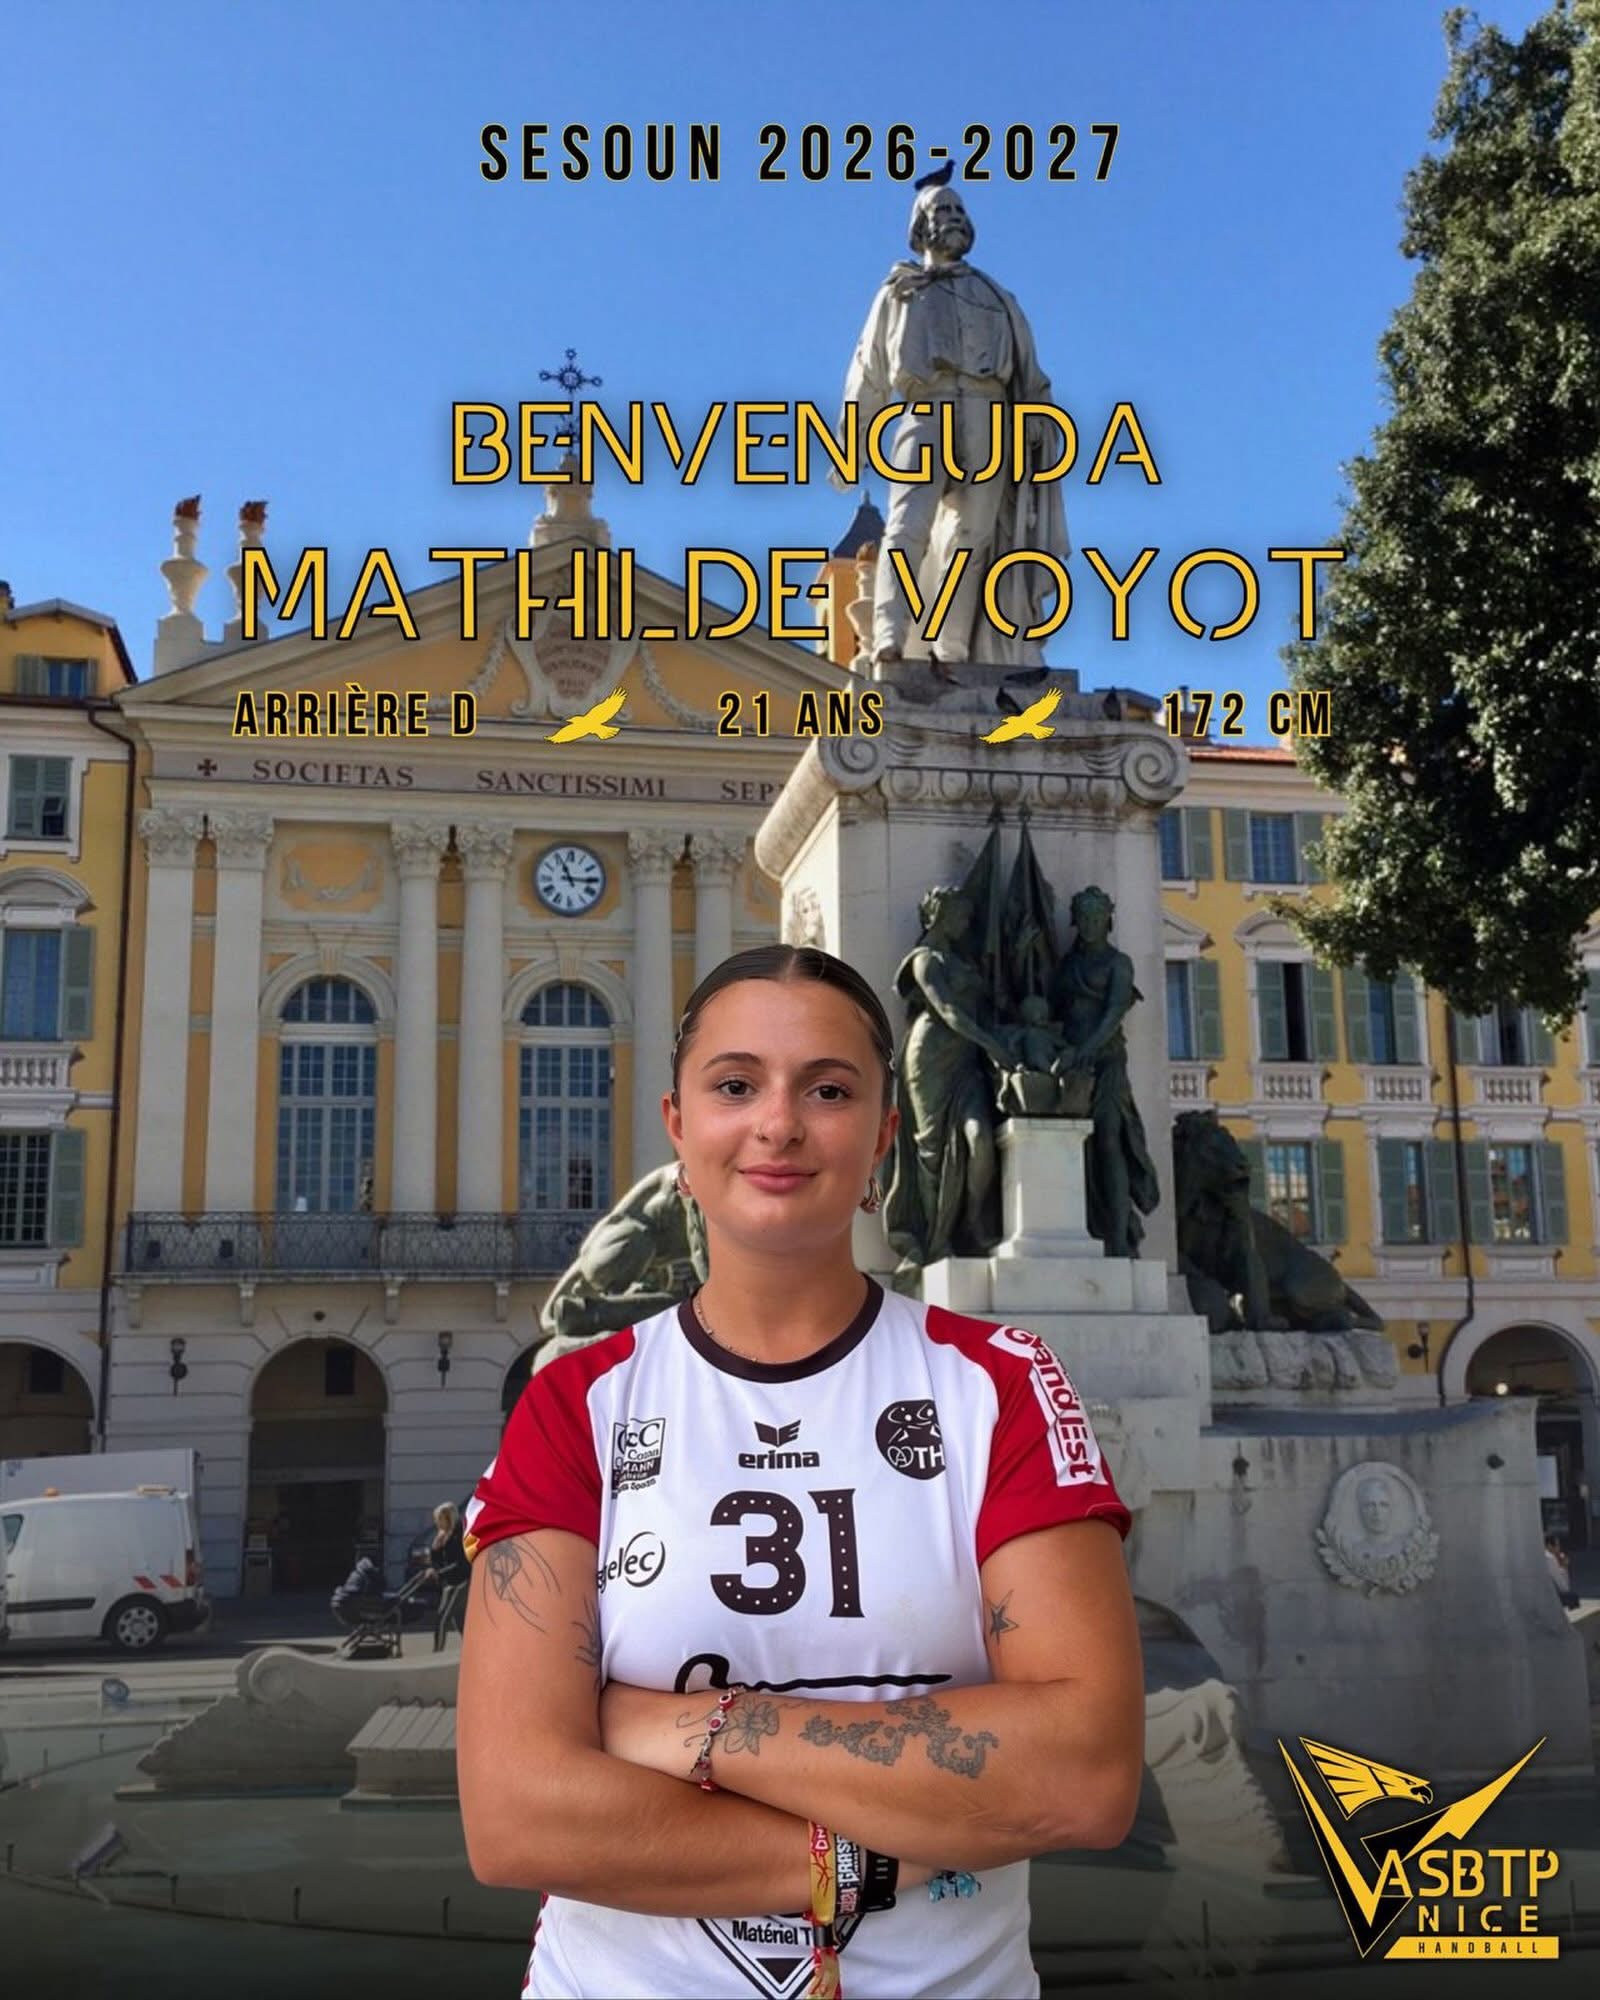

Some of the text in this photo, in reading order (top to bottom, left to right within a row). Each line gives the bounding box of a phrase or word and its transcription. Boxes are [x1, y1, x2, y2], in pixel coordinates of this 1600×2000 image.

[252, 759, 786, 801] SOCIETAS SANCTISSIMI SEP
[738, 1449, 820, 1470] erima
[709, 1488, 865, 1618] 31
[731, 1920, 799, 1946] Matériel
